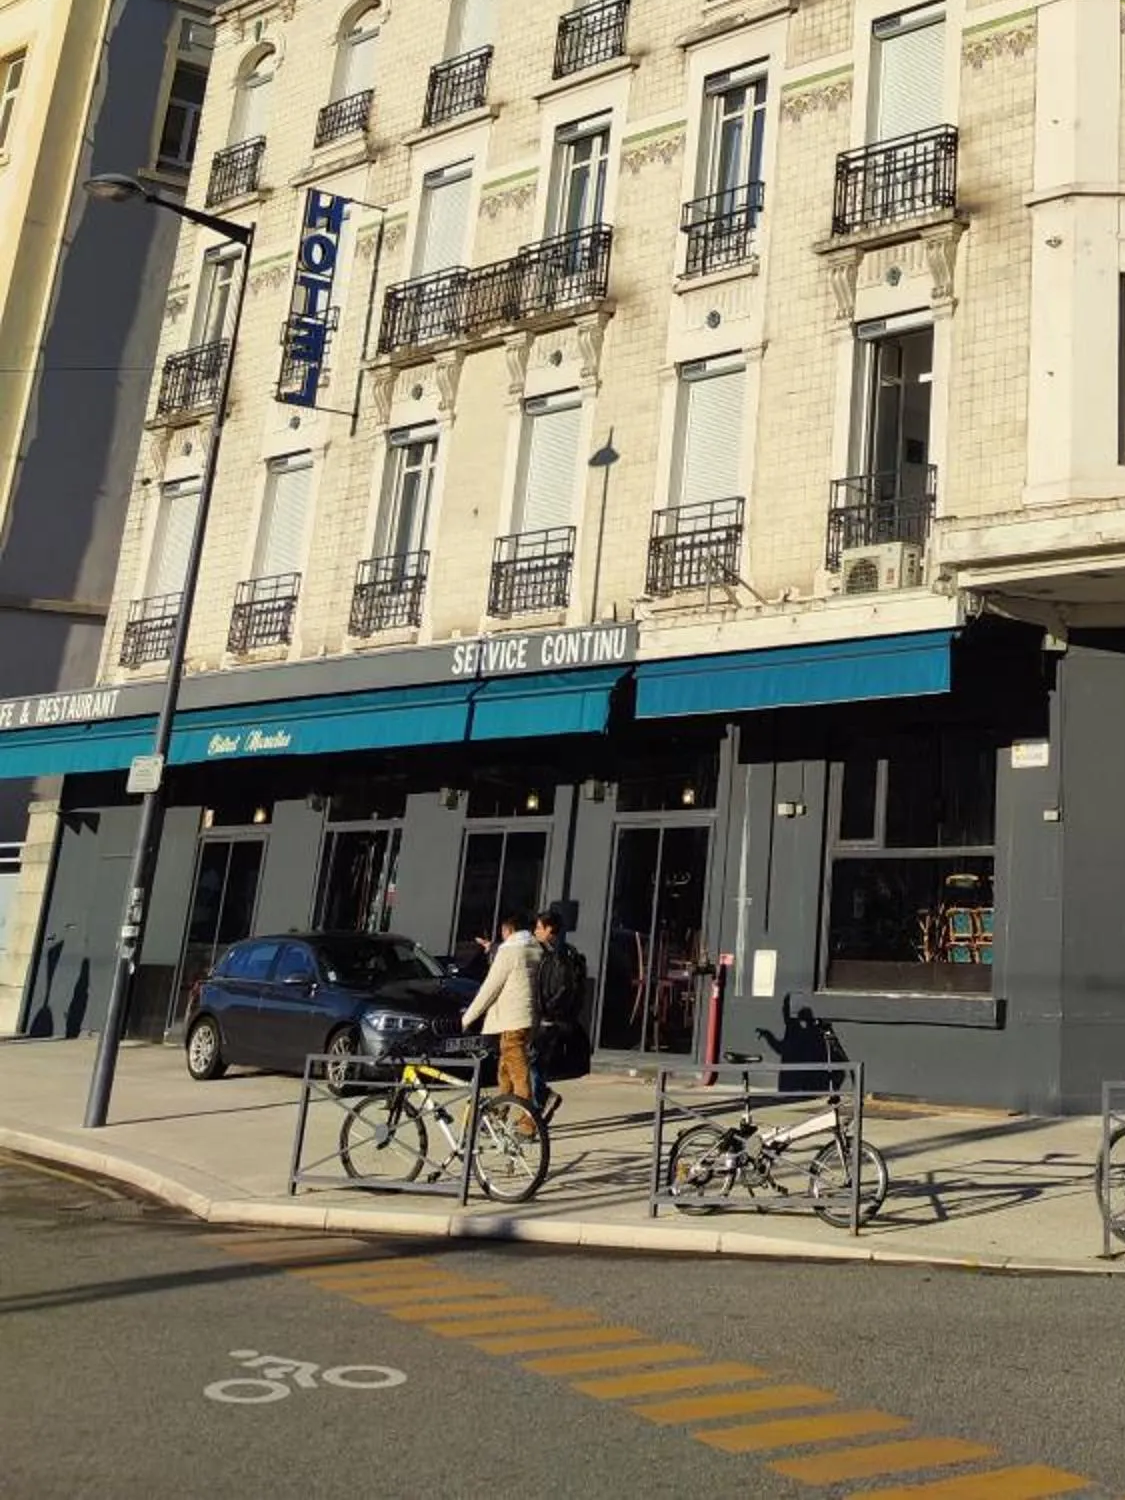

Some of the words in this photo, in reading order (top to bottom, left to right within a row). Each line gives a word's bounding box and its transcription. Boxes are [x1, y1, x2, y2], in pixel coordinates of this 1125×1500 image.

[451, 638, 529, 674] SERVICE
[541, 628, 627, 665] CONTINU
[36, 689, 120, 722] RESTAURANT
